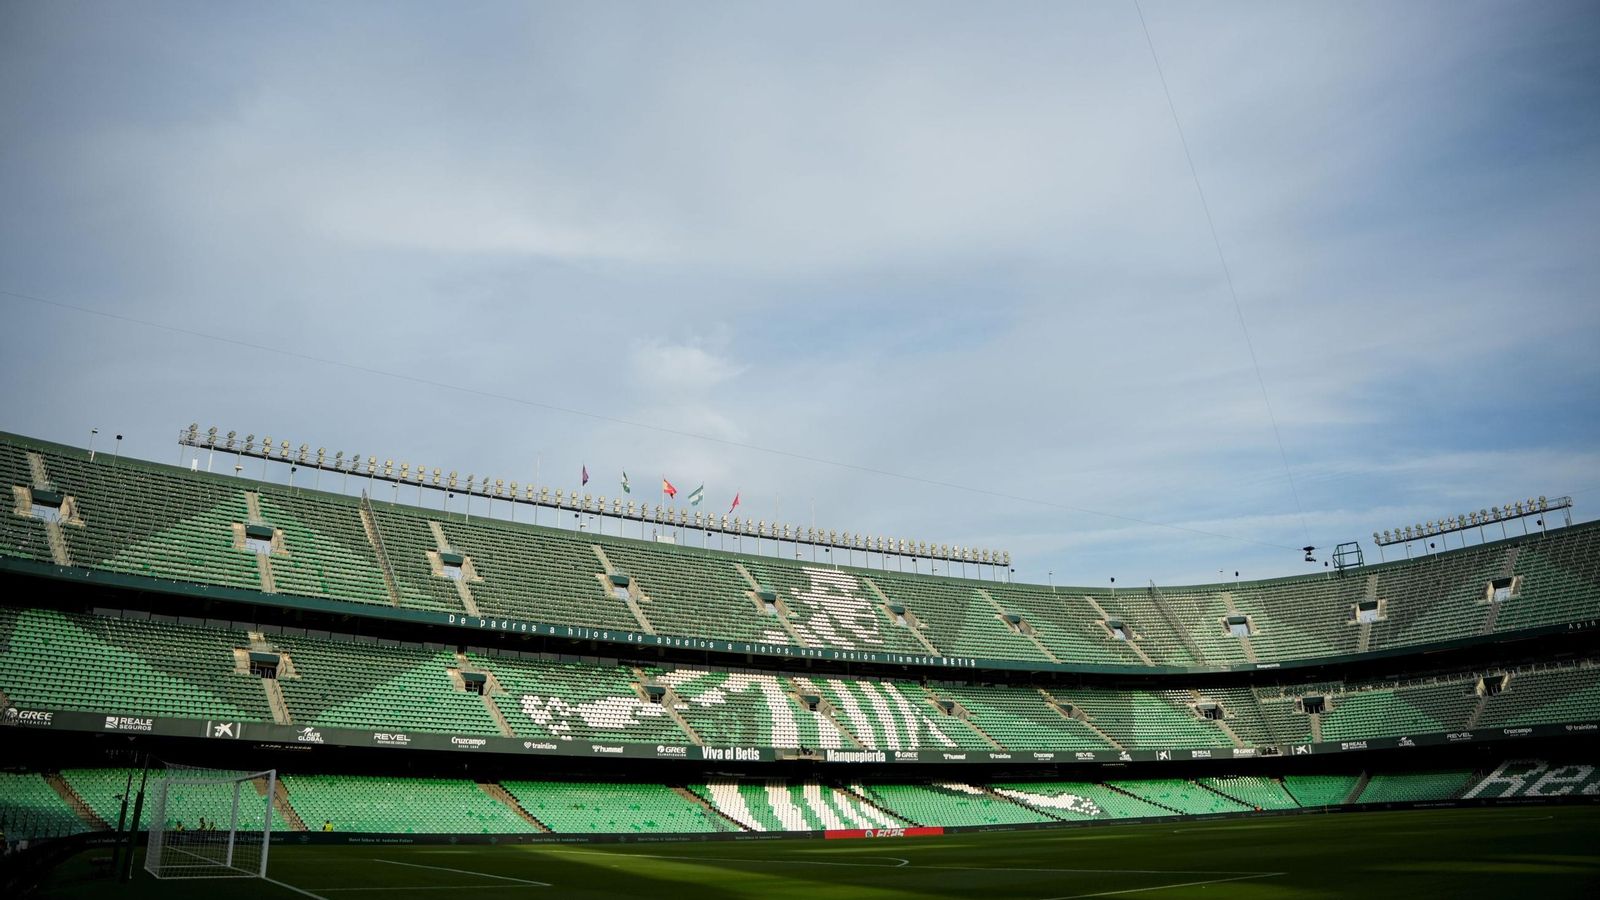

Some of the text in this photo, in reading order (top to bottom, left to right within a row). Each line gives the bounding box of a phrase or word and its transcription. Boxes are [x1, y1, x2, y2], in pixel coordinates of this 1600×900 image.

[449, 615, 467, 624] De
[480, 618, 537, 632] padres
[628, 633, 642, 642] de
[657, 636, 714, 649] abuelos
[801, 649, 823, 657] una
[834, 651, 876, 660] pasión
[887, 654, 934, 665] llamada
[943, 657, 976, 667] BETIS
[19, 710, 53, 720] GREE
[120, 717, 153, 726] REALE
[297, 735, 324, 744] GLOBAL
[373, 732, 411, 741] REVEL
[451, 736, 486, 746] Cruzcampo
[532, 742, 557, 750] trainline
[600, 745, 623, 753] hummel
[665, 746, 687, 754] GREE
[702, 746, 760, 761] Viva el Betis
[827, 749, 886, 764] Manquepierda
